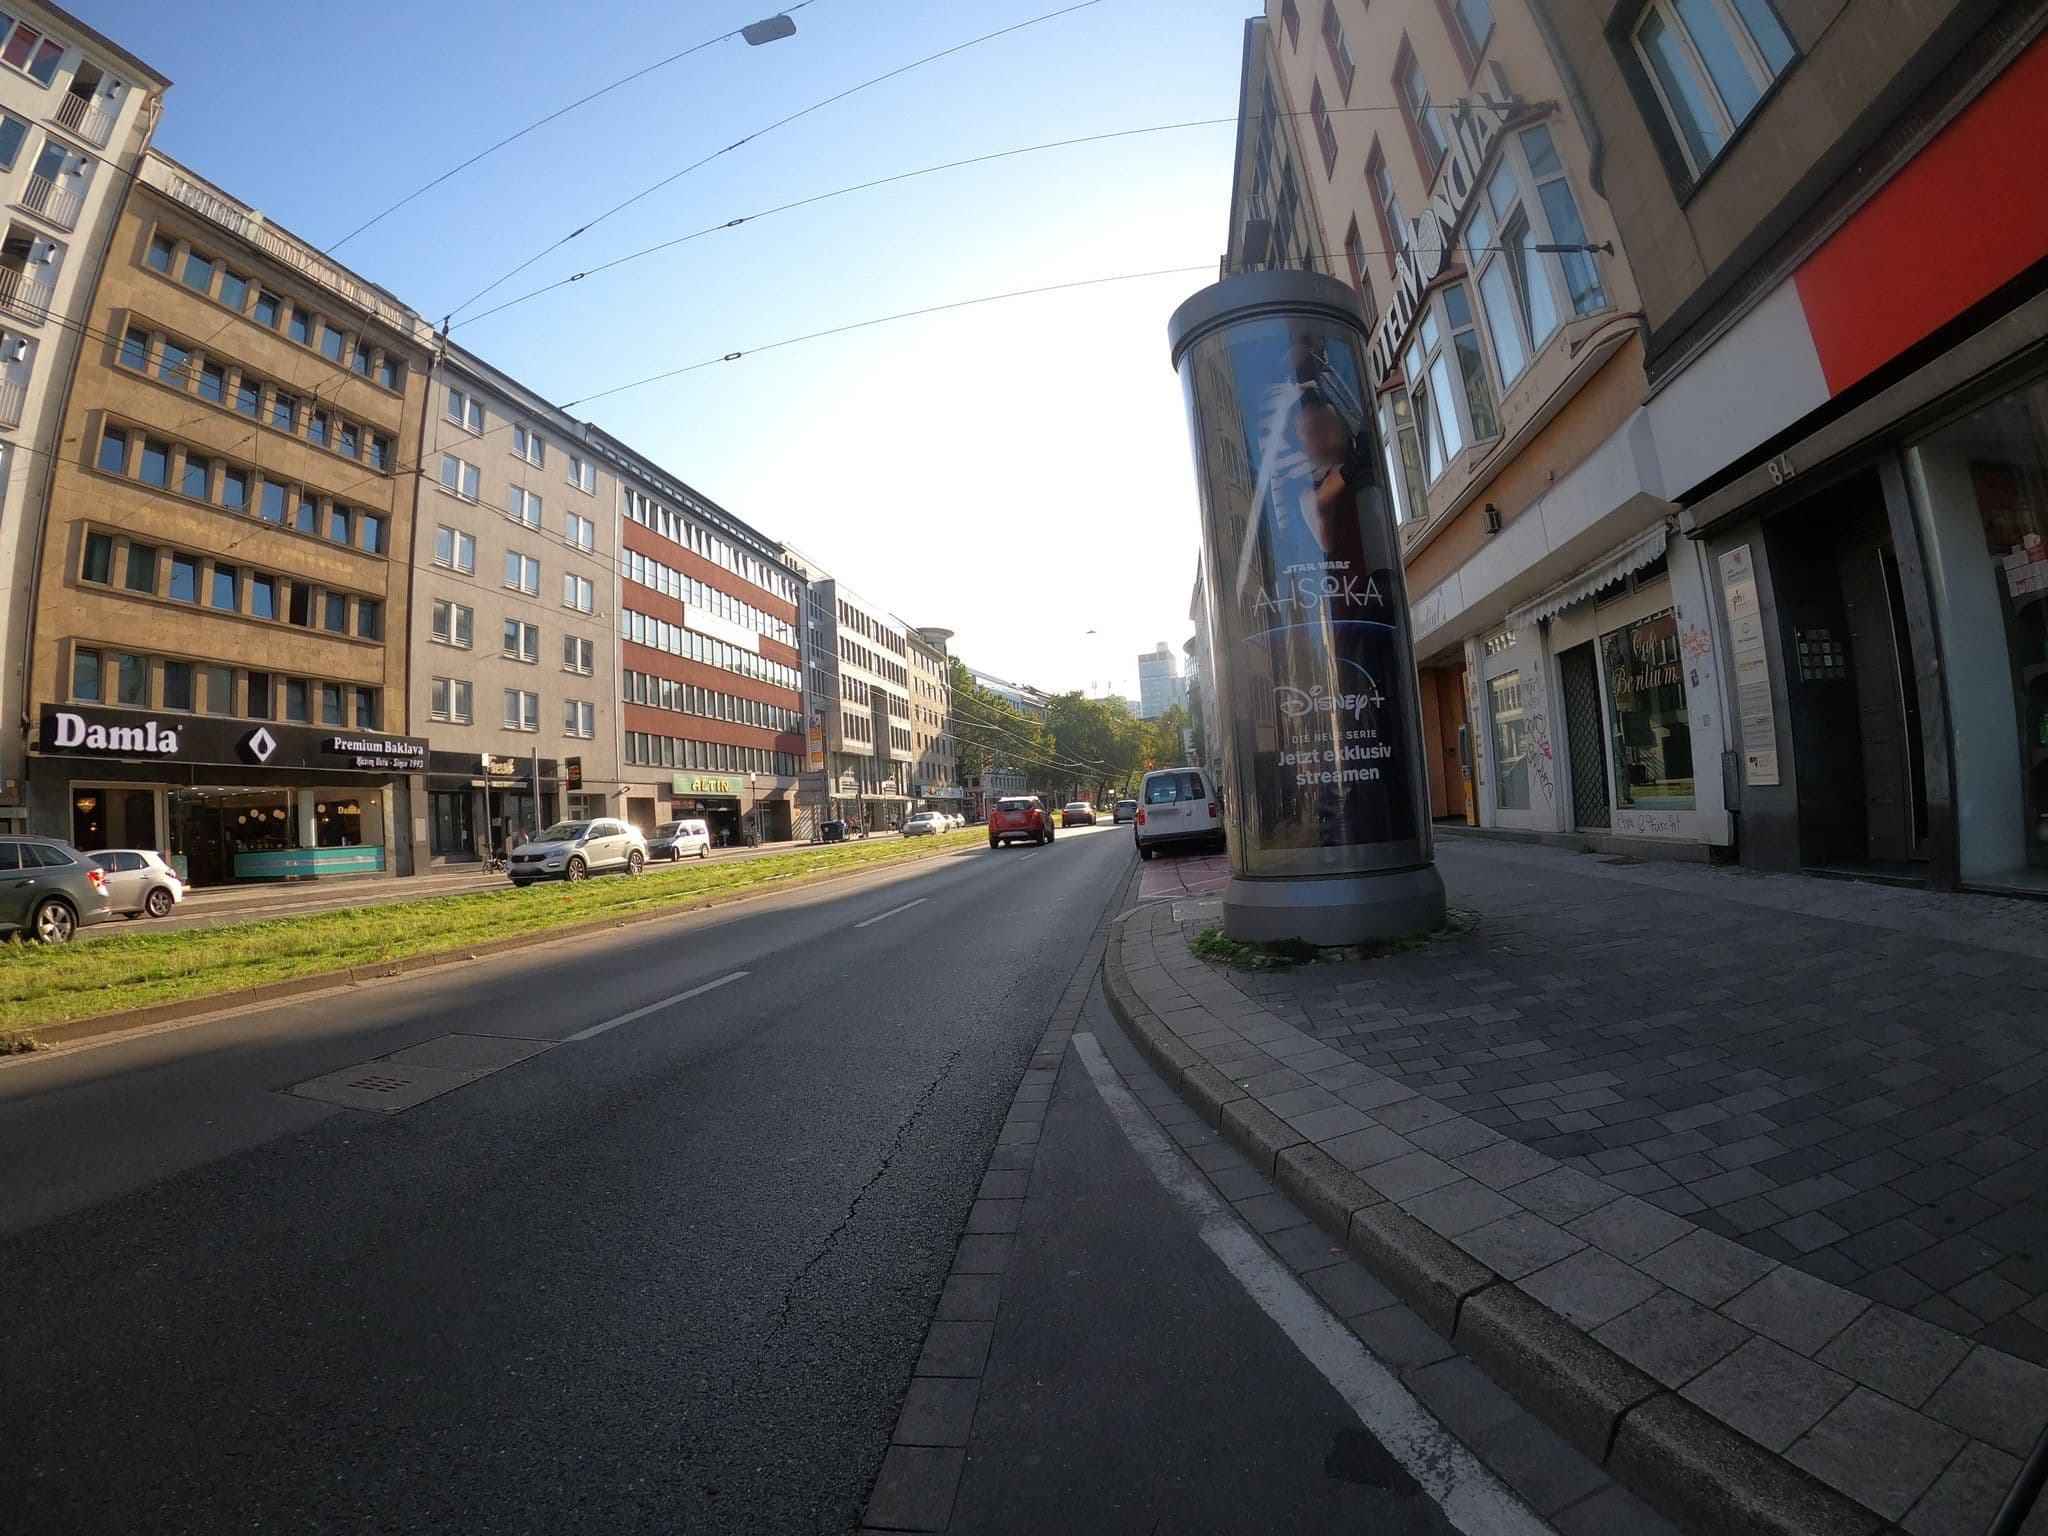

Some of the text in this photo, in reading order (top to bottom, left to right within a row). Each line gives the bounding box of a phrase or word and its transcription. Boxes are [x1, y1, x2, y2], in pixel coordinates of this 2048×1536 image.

[1370, 288, 1411, 386] OTEL
[1768, 455, 1796, 486] 84
[1283, 560, 1351, 574] STAR WARS
[1252, 575, 1384, 616] AHSOKA
[1273, 684, 1386, 721] Disney+
[54, 712, 179, 753] Damla
[1291, 729, 1377, 744] DIE NEUE SERIE
[334, 736, 424, 755] Premium Baklava
[1278, 742, 1392, 767] Jetzt exklusiv
[691, 779, 730, 793] ALTIN
[1296, 767, 1380, 786] streamen
